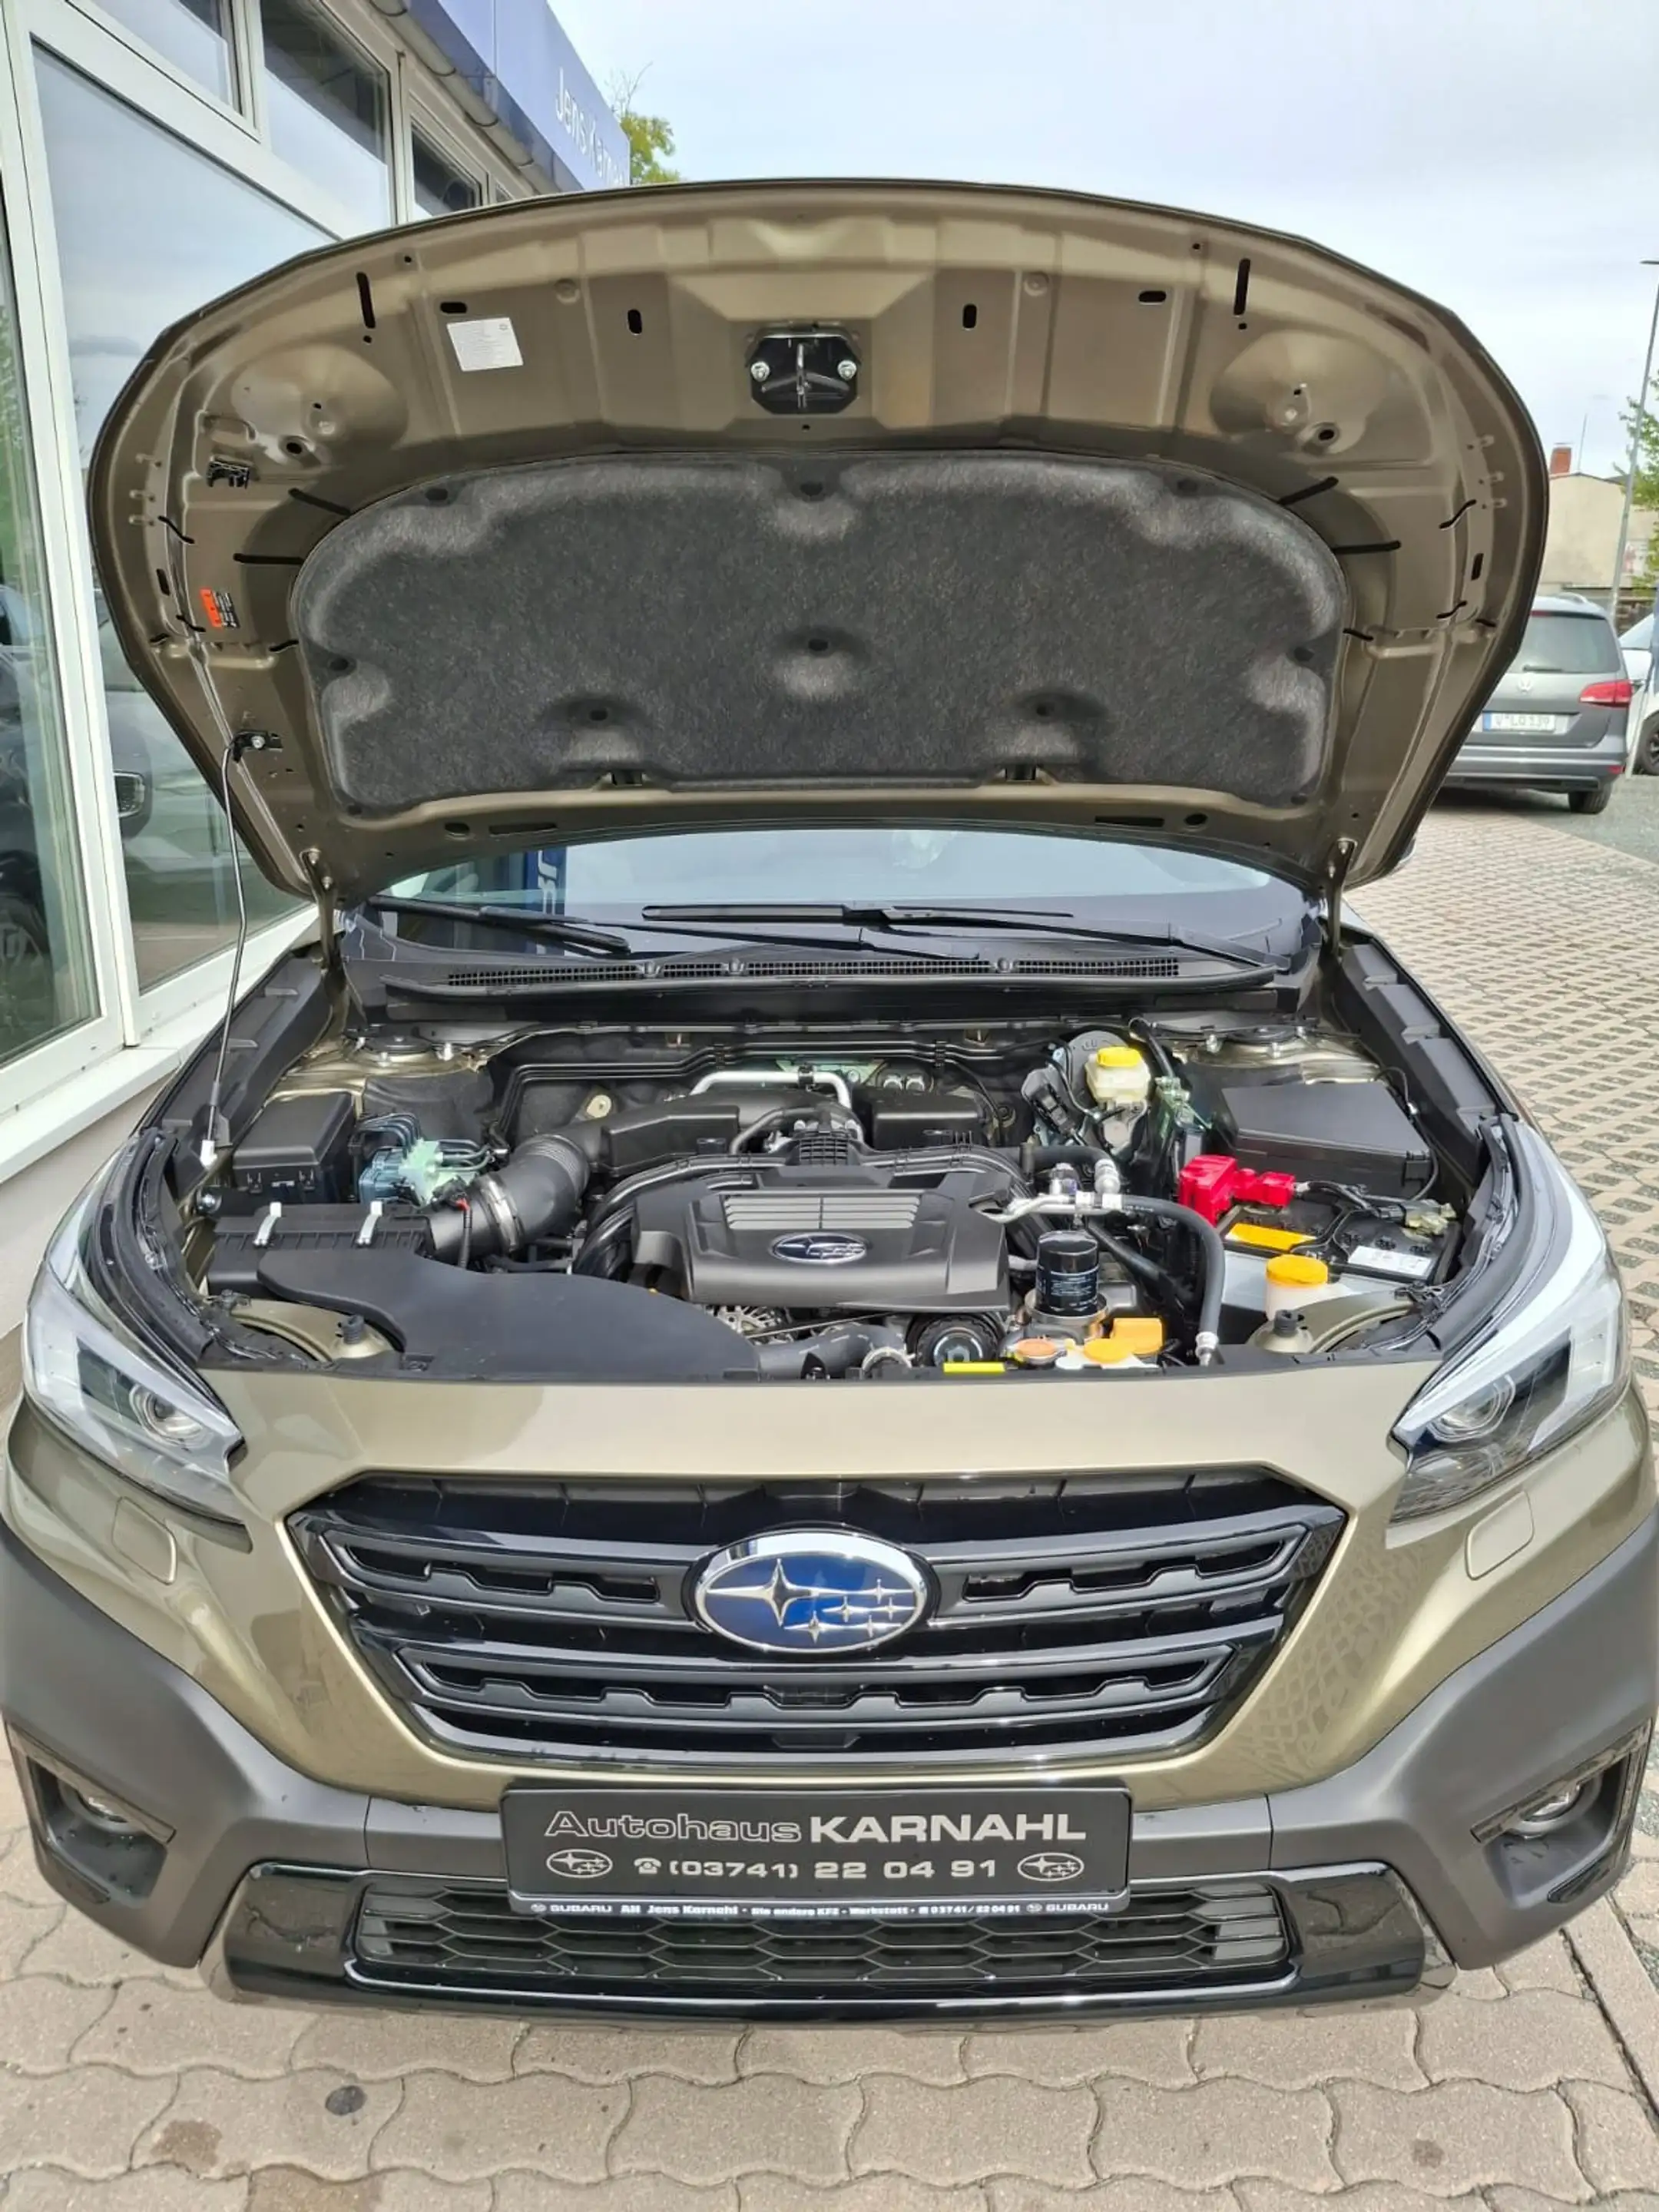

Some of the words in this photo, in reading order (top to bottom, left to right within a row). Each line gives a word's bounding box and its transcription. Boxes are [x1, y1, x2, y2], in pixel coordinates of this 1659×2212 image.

[555, 66, 587, 156] Jens
[544, 1810, 802, 1843] Autohaus
[810, 1813, 1087, 1844] KARNAHL
[669, 1859, 799, 1879] (03741)
[813, 1861, 867, 1879] 22
[882, 1860, 935, 1879] 04
[950, 1859, 995, 1879] 91
[550, 1903, 612, 1914] SUBARU
[647, 1905, 680, 1916] Jens
[1045, 1902, 1109, 1912] SUBARU
